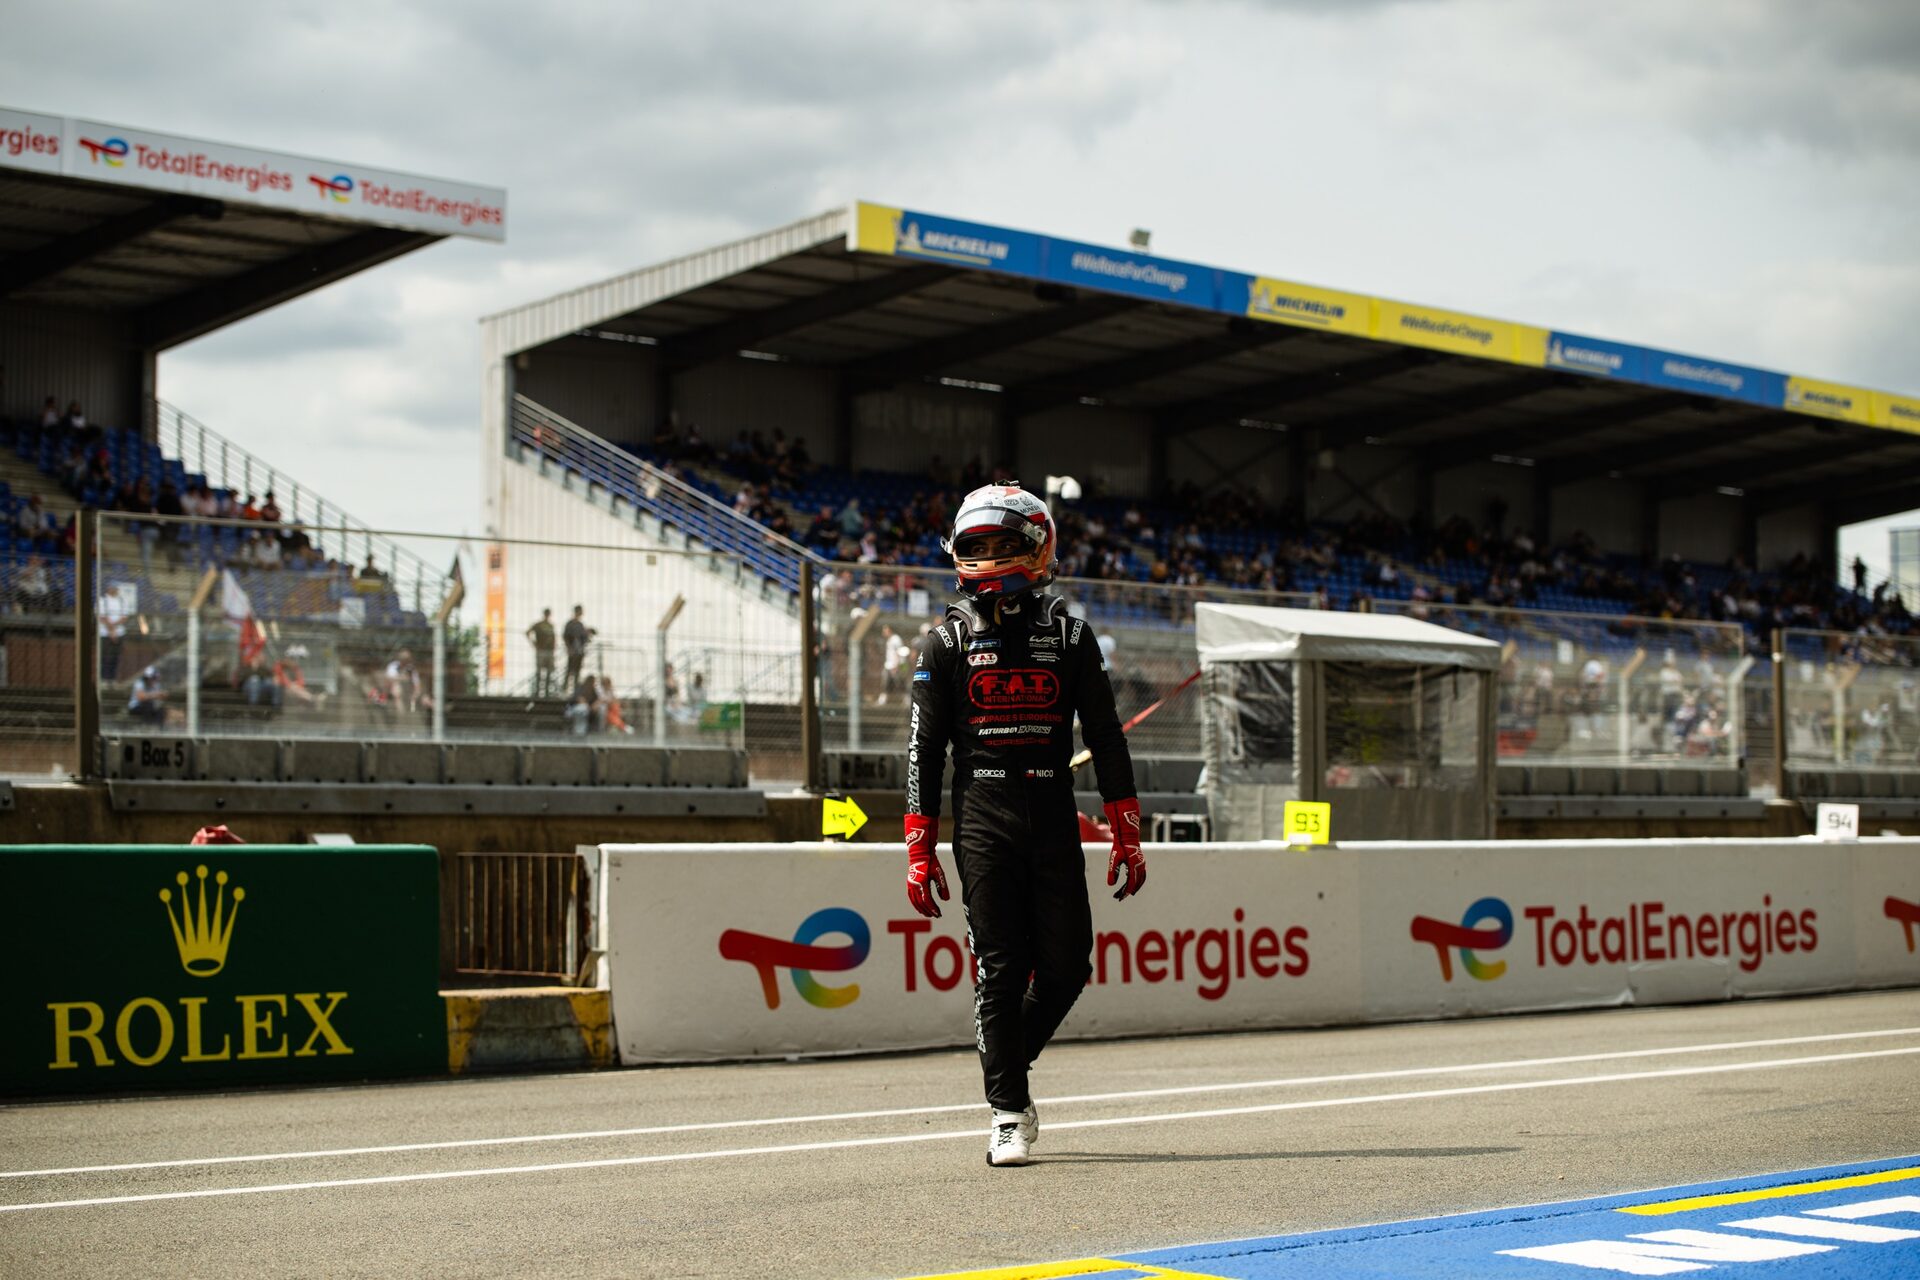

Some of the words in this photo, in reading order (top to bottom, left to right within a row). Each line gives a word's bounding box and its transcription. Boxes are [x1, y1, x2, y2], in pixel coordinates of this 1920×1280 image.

[134, 144, 293, 192] TotalEnergies
[359, 180, 504, 226] TotalEnergies
[923, 230, 1009, 260] MICHELIN
[1275, 294, 1345, 320] MICHELIN
[983, 694, 1047, 704] INTERNATIONAL
[141, 740, 170, 767] Box
[175, 741, 185, 768] 5
[973, 769, 1006, 778] sparco
[1036, 769, 1054, 778] NICO
[1295, 812, 1320, 833] 93
[1828, 811, 1852, 831] 94
[1524, 894, 1819, 972] TotalEnergies
[887, 908, 1310, 1001] Tonergies
[47, 992, 354, 1069] ROLEX
